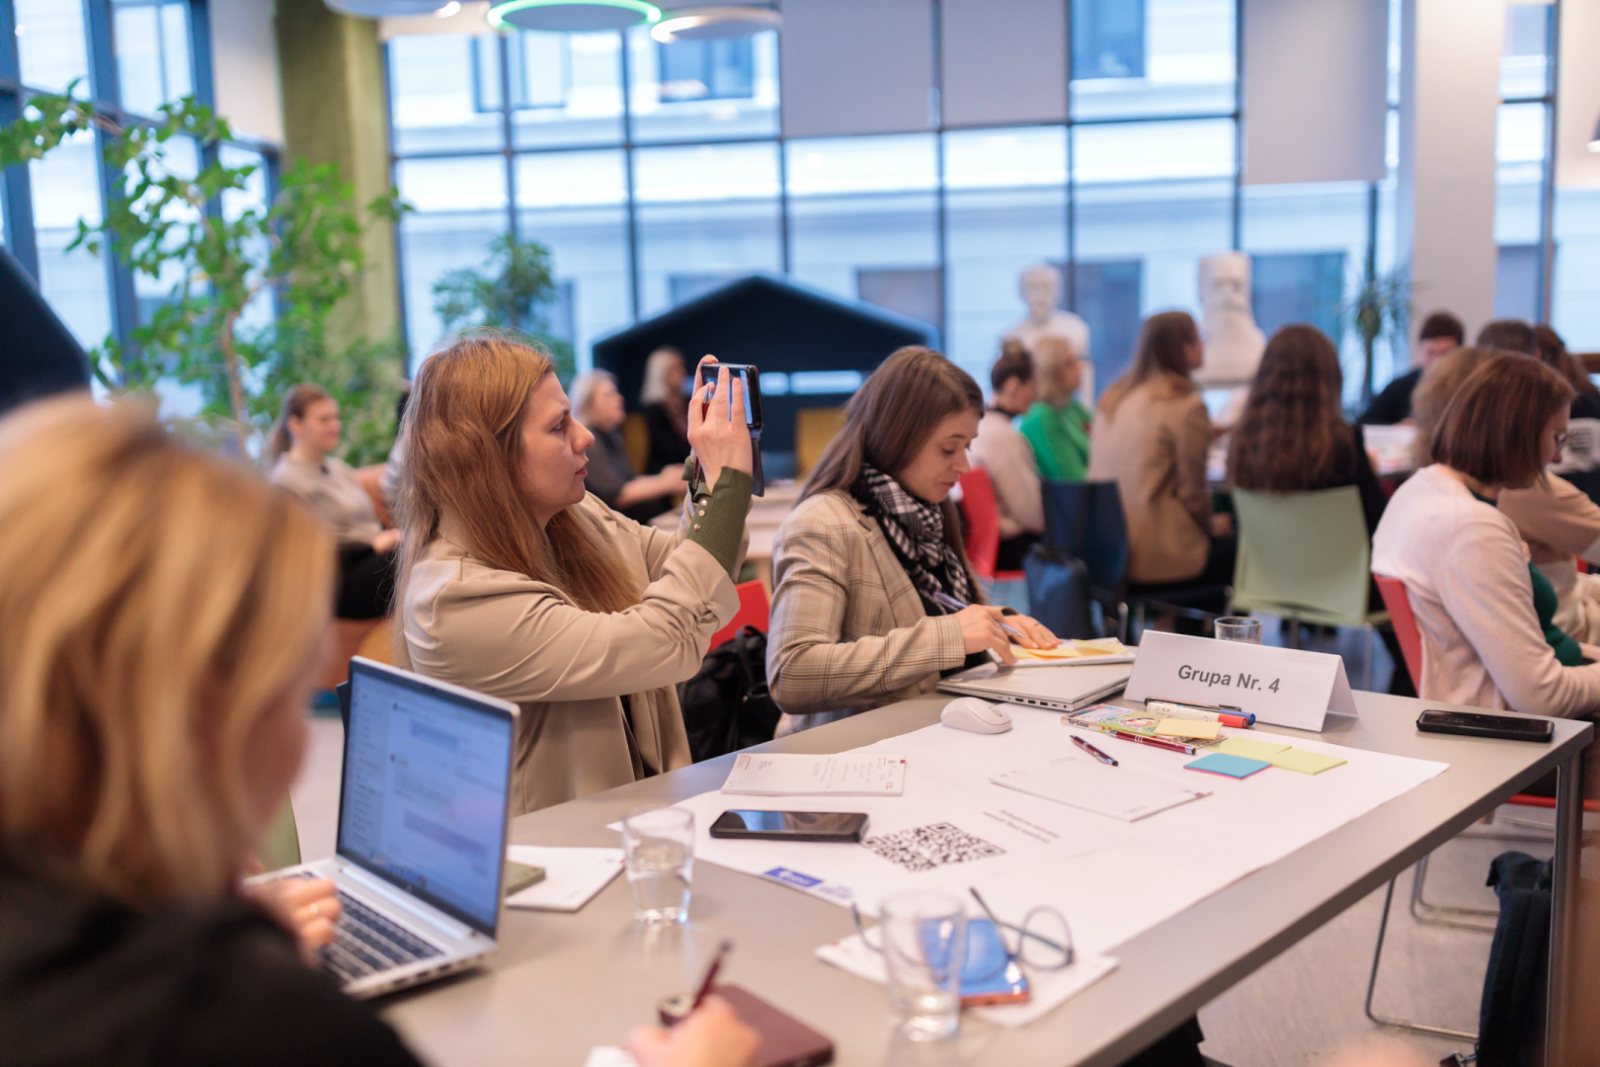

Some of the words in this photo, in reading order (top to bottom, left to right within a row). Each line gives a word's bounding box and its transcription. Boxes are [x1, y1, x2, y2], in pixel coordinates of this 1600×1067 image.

[1178, 664, 1231, 687] Grupa
[1236, 673, 1262, 691] Nr.
[1268, 678, 1280, 693] 4
